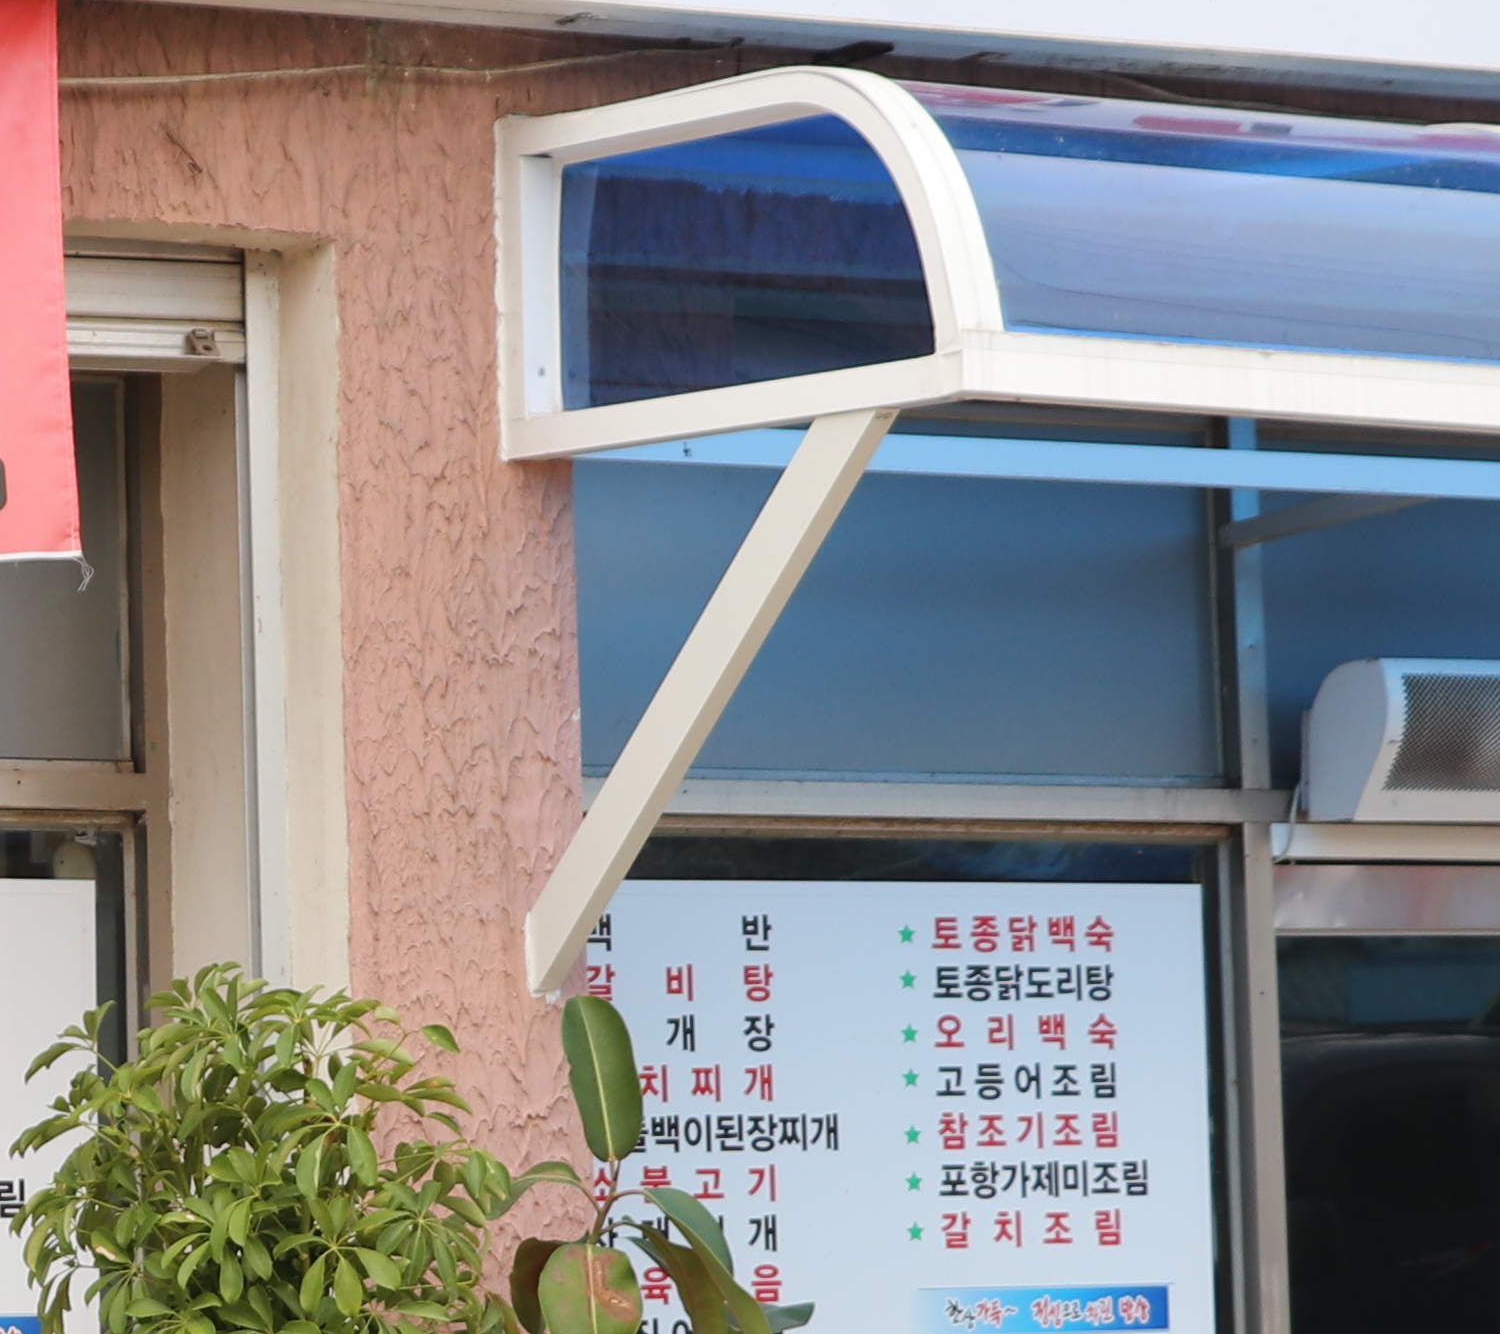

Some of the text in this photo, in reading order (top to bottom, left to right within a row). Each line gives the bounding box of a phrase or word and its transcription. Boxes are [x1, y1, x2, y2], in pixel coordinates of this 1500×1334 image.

[932, 916, 1114, 953] 토종닭백숙
[933, 965, 1114, 1002] 토종닭도리탕
[666, 1014, 775, 1052] 개장
[935, 1014, 1117, 1050] 오리백숙
[638, 1064, 774, 1103] 치찌개
[936, 1062, 1117, 1100] 고등어조림
[630, 1112, 840, 1154] 백이된장찌개
[938, 1112, 1119, 1150] 참조기조림
[939, 1160, 1148, 1199] 포항가제미조림
[941, 1209, 1122, 1249] 갈치조림
